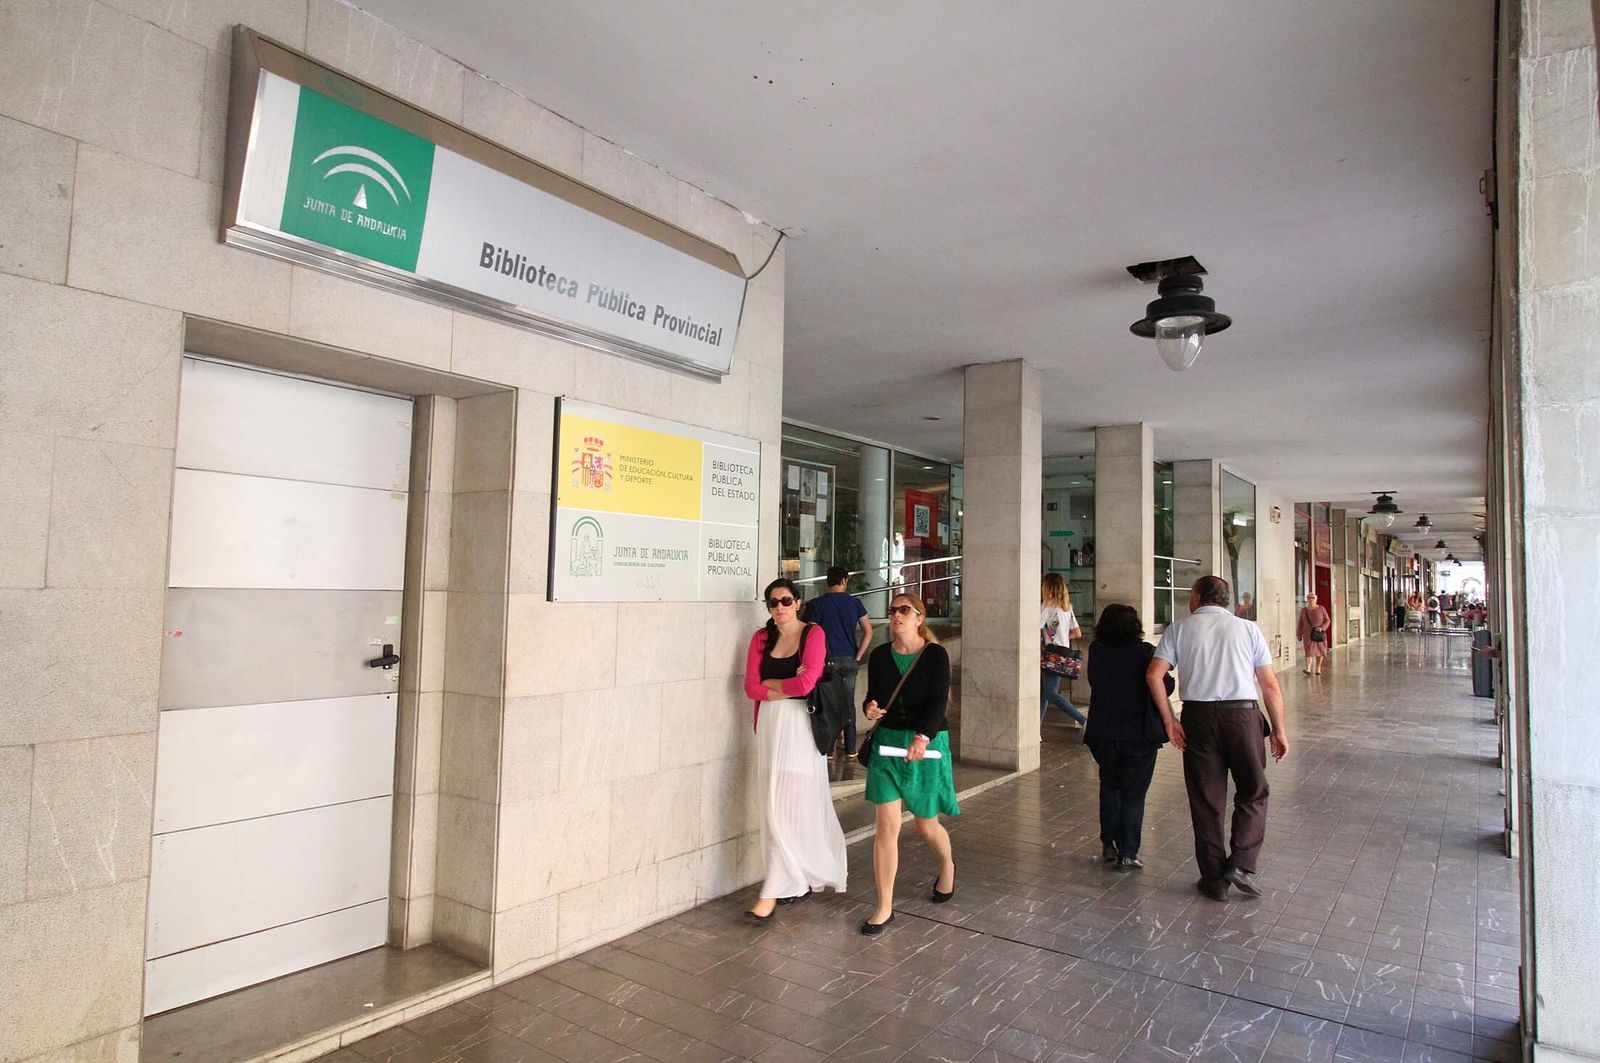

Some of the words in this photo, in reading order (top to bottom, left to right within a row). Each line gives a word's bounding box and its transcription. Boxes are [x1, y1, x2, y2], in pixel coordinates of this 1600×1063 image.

[303, 197, 336, 217] JUNTA
[341, 208, 353, 224] DE
[357, 214, 407, 241] ANDALUCIA
[479, 241, 578, 299] Biblioteca
[586, 281, 646, 322] Pública
[653, 304, 723, 347] Provincial
[620, 455, 654, 467] MINISTERIO
[712, 460, 754, 475] BIBLIOTECA
[620, 464, 628, 472] DE
[667, 472, 694, 481] CULTURA
[712, 472, 743, 487] PÚBLICA
[625, 475, 653, 485] DEPORTE
[711, 487, 726, 497] DEL
[727, 489, 756, 501] ESTADO
[708, 538, 751, 550] BIBLIOTECA
[612, 546, 637, 559] JUNTA
[640, 548, 649, 559] DE
[652, 548, 689, 560] ANDALUCIA
[708, 549, 740, 563] PÚBLICA
[707, 565, 752, 576] PROVINCIAL
